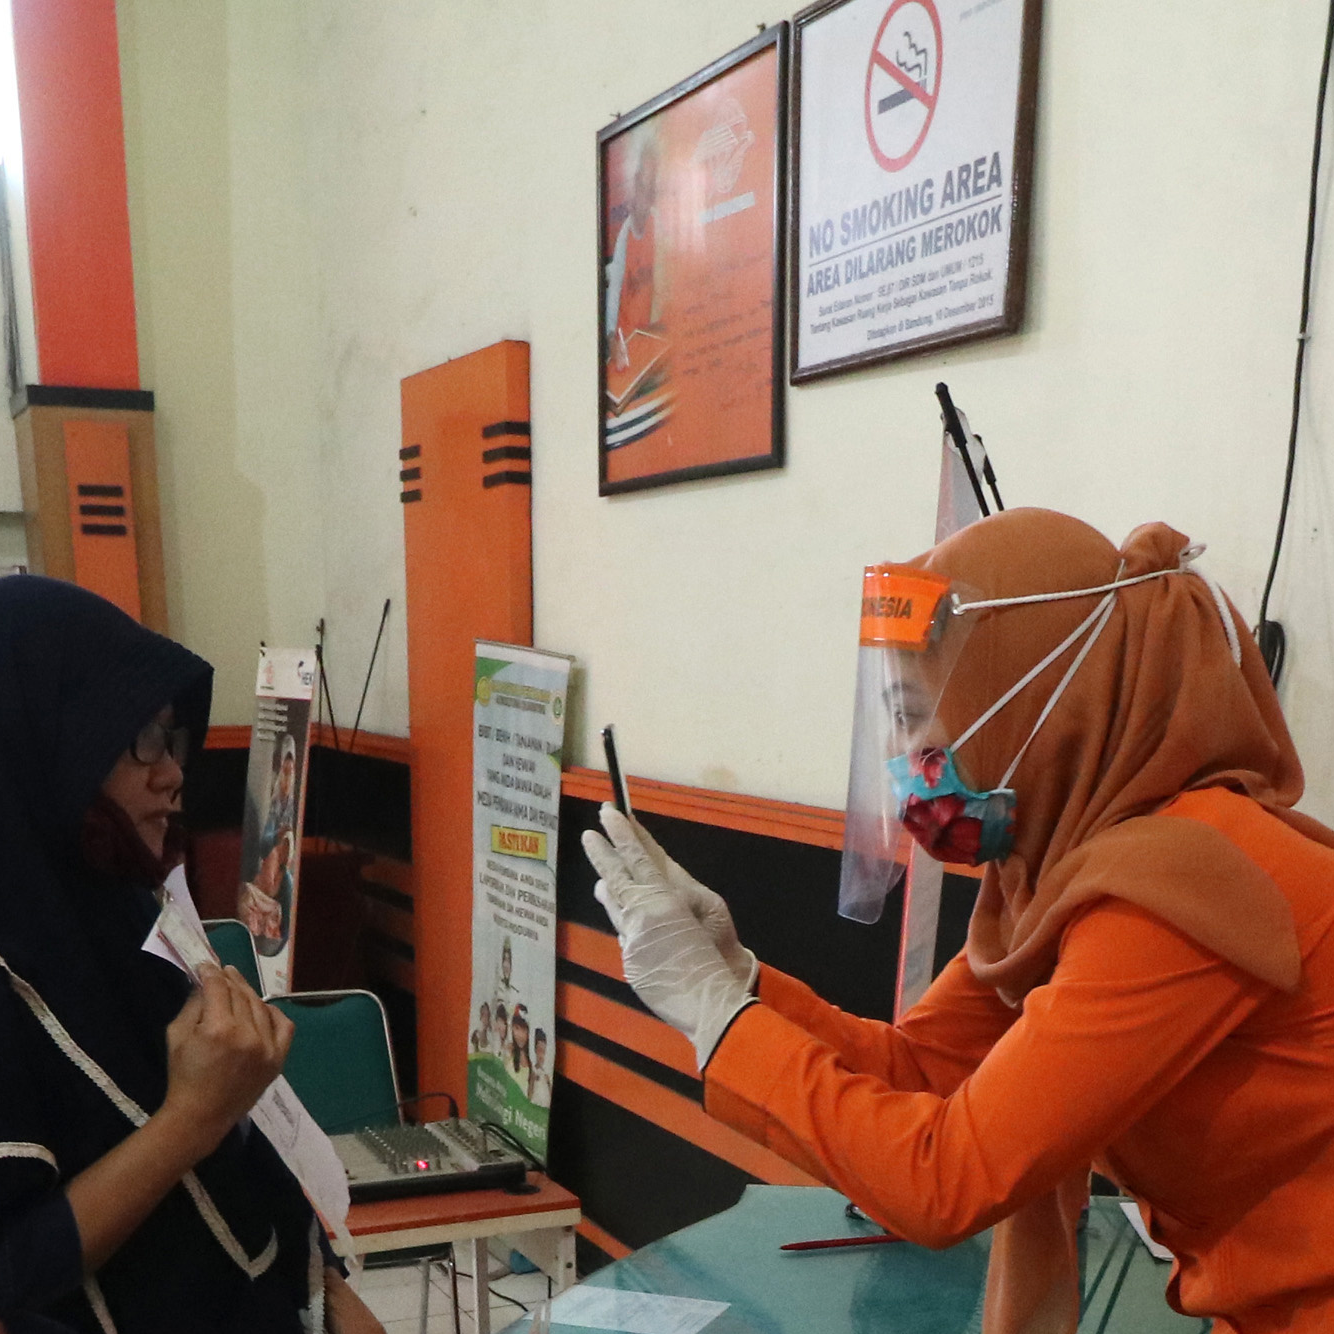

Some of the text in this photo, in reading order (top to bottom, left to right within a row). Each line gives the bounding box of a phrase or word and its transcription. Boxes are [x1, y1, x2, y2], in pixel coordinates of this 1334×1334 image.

[806, 203, 1003, 298] AREA DILARANG MEROKOK
[809, 151, 1003, 259] NO SMOKING AREA
